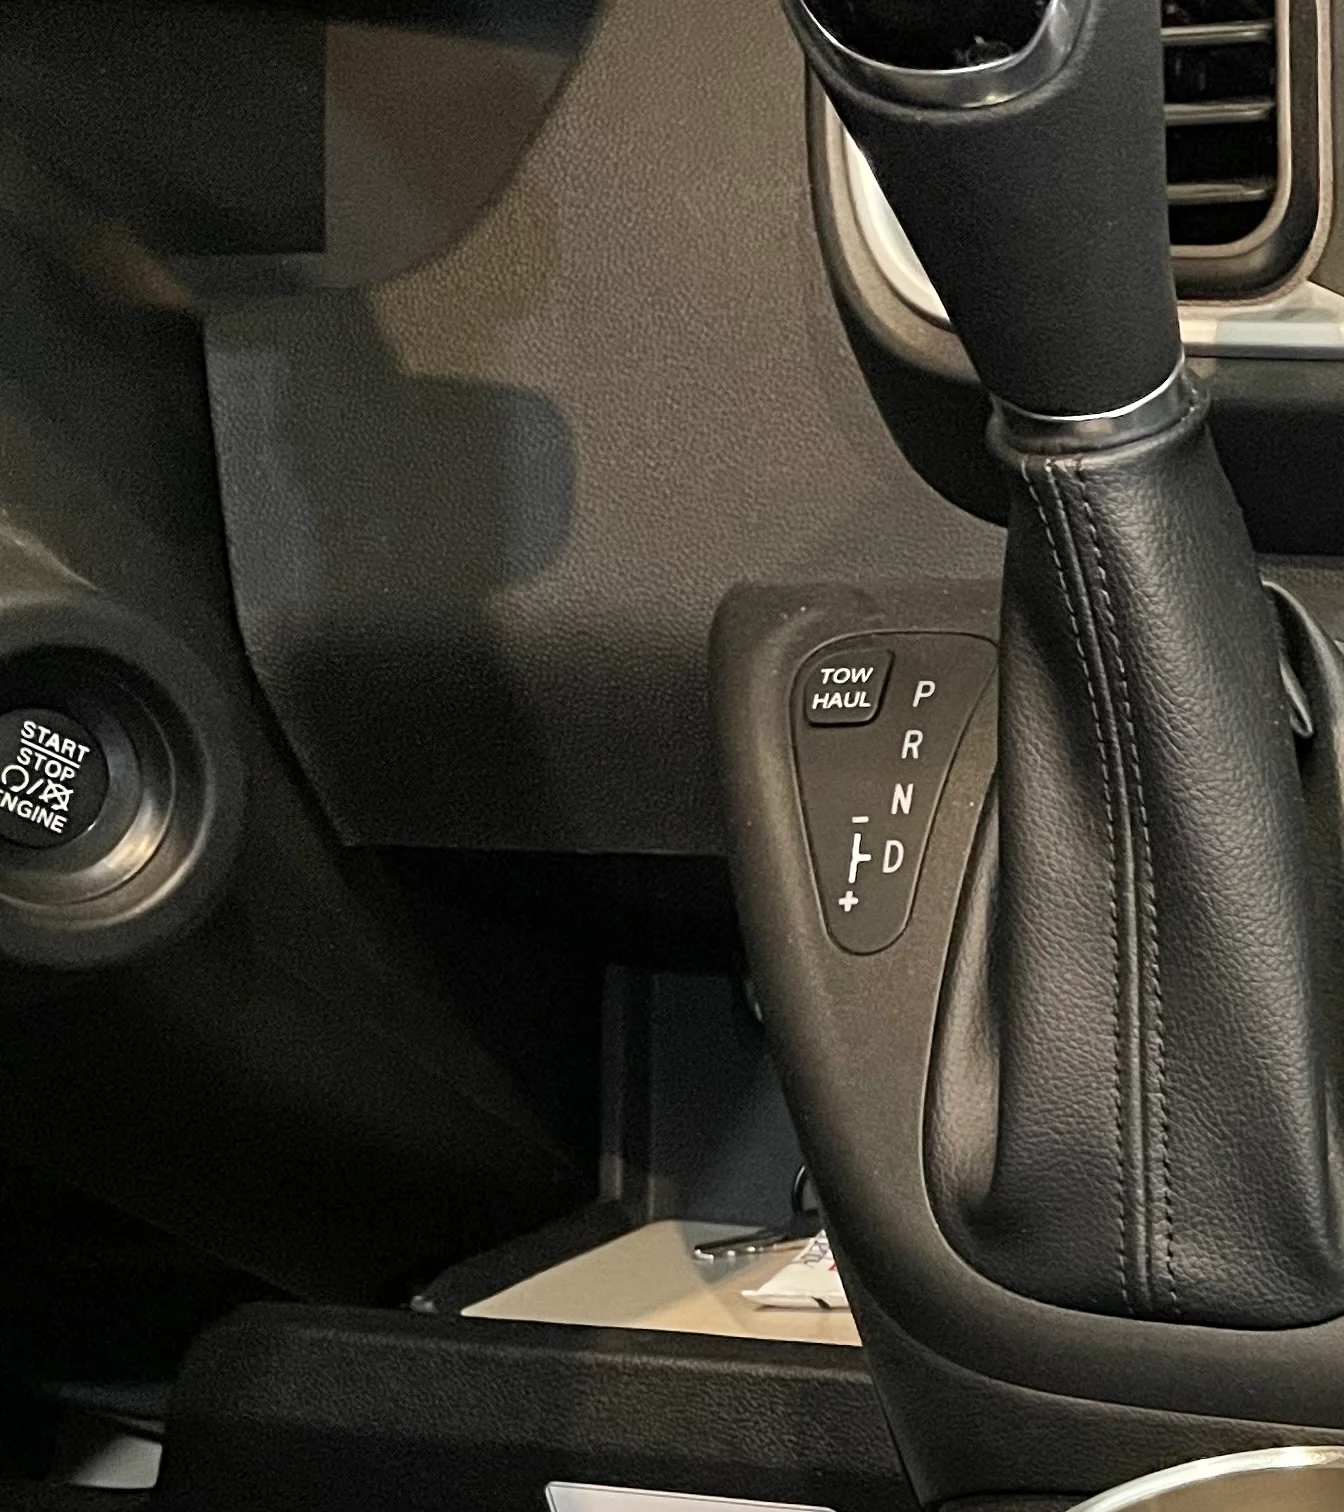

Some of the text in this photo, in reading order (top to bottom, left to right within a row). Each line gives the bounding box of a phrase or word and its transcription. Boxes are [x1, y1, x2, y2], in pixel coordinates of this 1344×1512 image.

[820, 667, 874, 684] TOW
[812, 691, 871, 709] HAUL
[912, 680, 936, 708] P
[20, 720, 90, 763] START
[901, 729, 924, 759] R
[16, 747, 75, 782] STOP
[0, 788, 67, 834] NGINE
[890, 783, 914, 814] N
[882, 839, 904, 873] D
